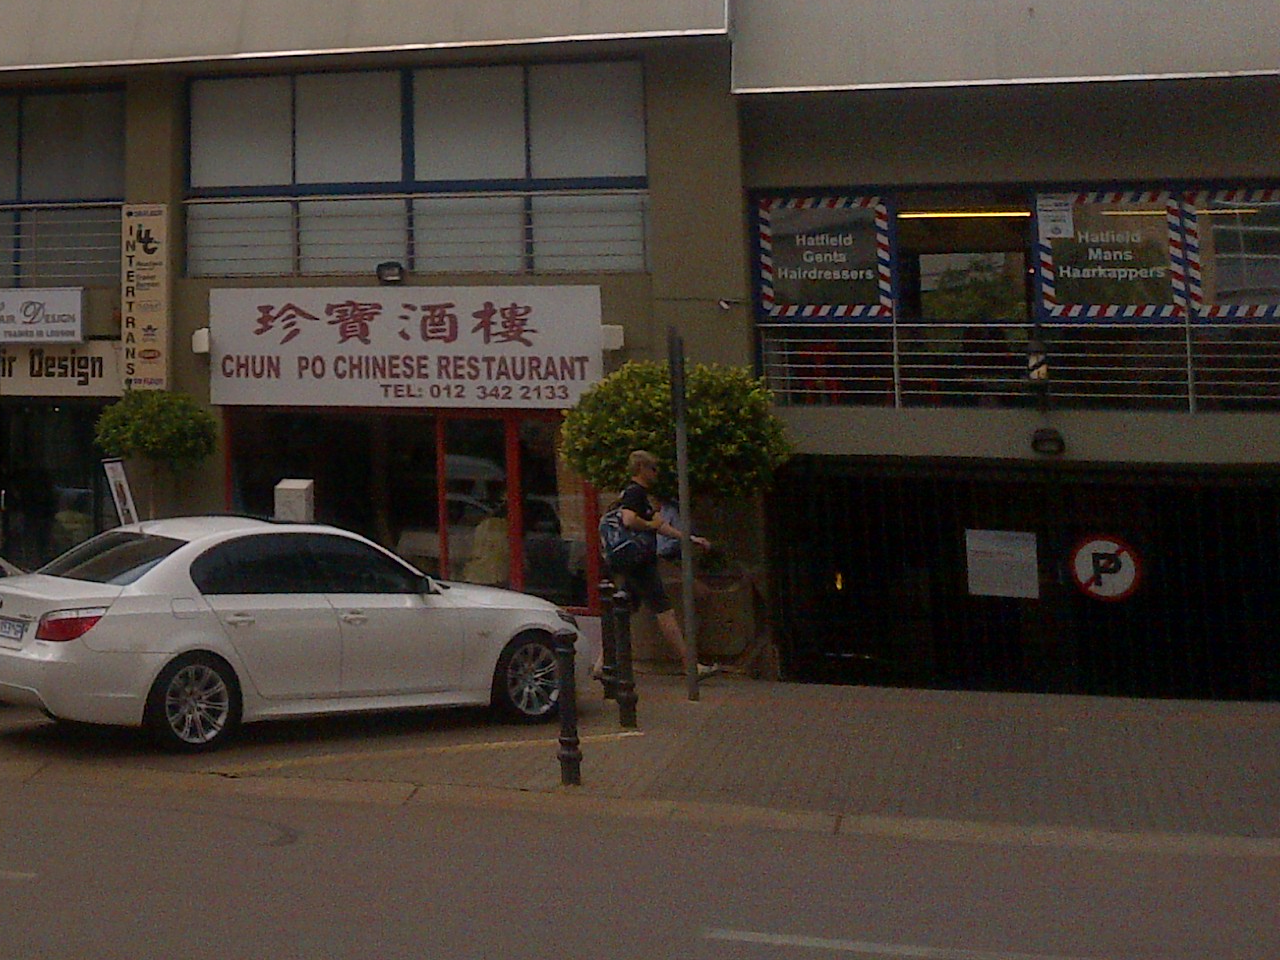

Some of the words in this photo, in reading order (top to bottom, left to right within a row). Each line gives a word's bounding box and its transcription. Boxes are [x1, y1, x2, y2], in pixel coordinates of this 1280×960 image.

[795, 233, 853, 246] Hatfield
[1076, 230, 1142, 244] Hatfield
[802, 250, 848, 263] Gents
[1088, 247, 1134, 261] Mans
[777, 267, 875, 280] Hairdressers
[1058, 265, 1166, 281] Haarkappers
[125, 225, 136, 376] INTERTRANS
[253, 300, 538, 347] 珍寶酒樓
[29, 348, 104, 386] Design
[221, 354, 281, 380] CHUN
[297, 354, 326, 380] PO
[333, 354, 430, 380] CHINESE
[437, 355, 590, 381] RESTAURANT
[380, 384, 424, 400] TEL:
[429, 385, 465, 399] 012
[475, 385, 513, 401] 342
[519, 386, 570, 401] 2133
[1092, 552, 1122, 587] P
